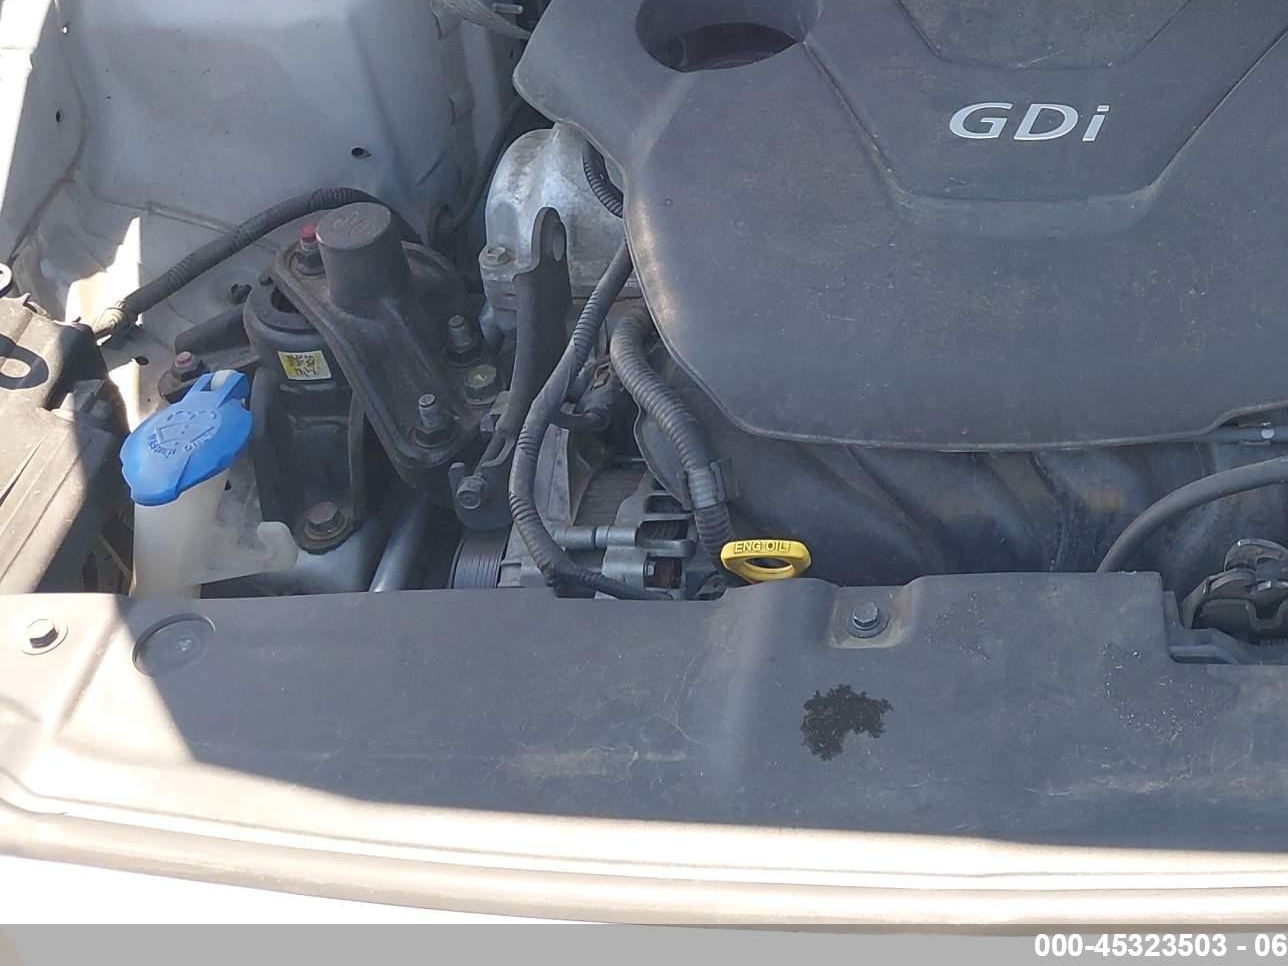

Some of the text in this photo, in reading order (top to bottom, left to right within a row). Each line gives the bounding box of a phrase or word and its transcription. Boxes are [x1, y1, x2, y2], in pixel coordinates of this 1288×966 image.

[949, 101, 1111, 142] GDi
[734, 541, 787, 554] ENG OIL
